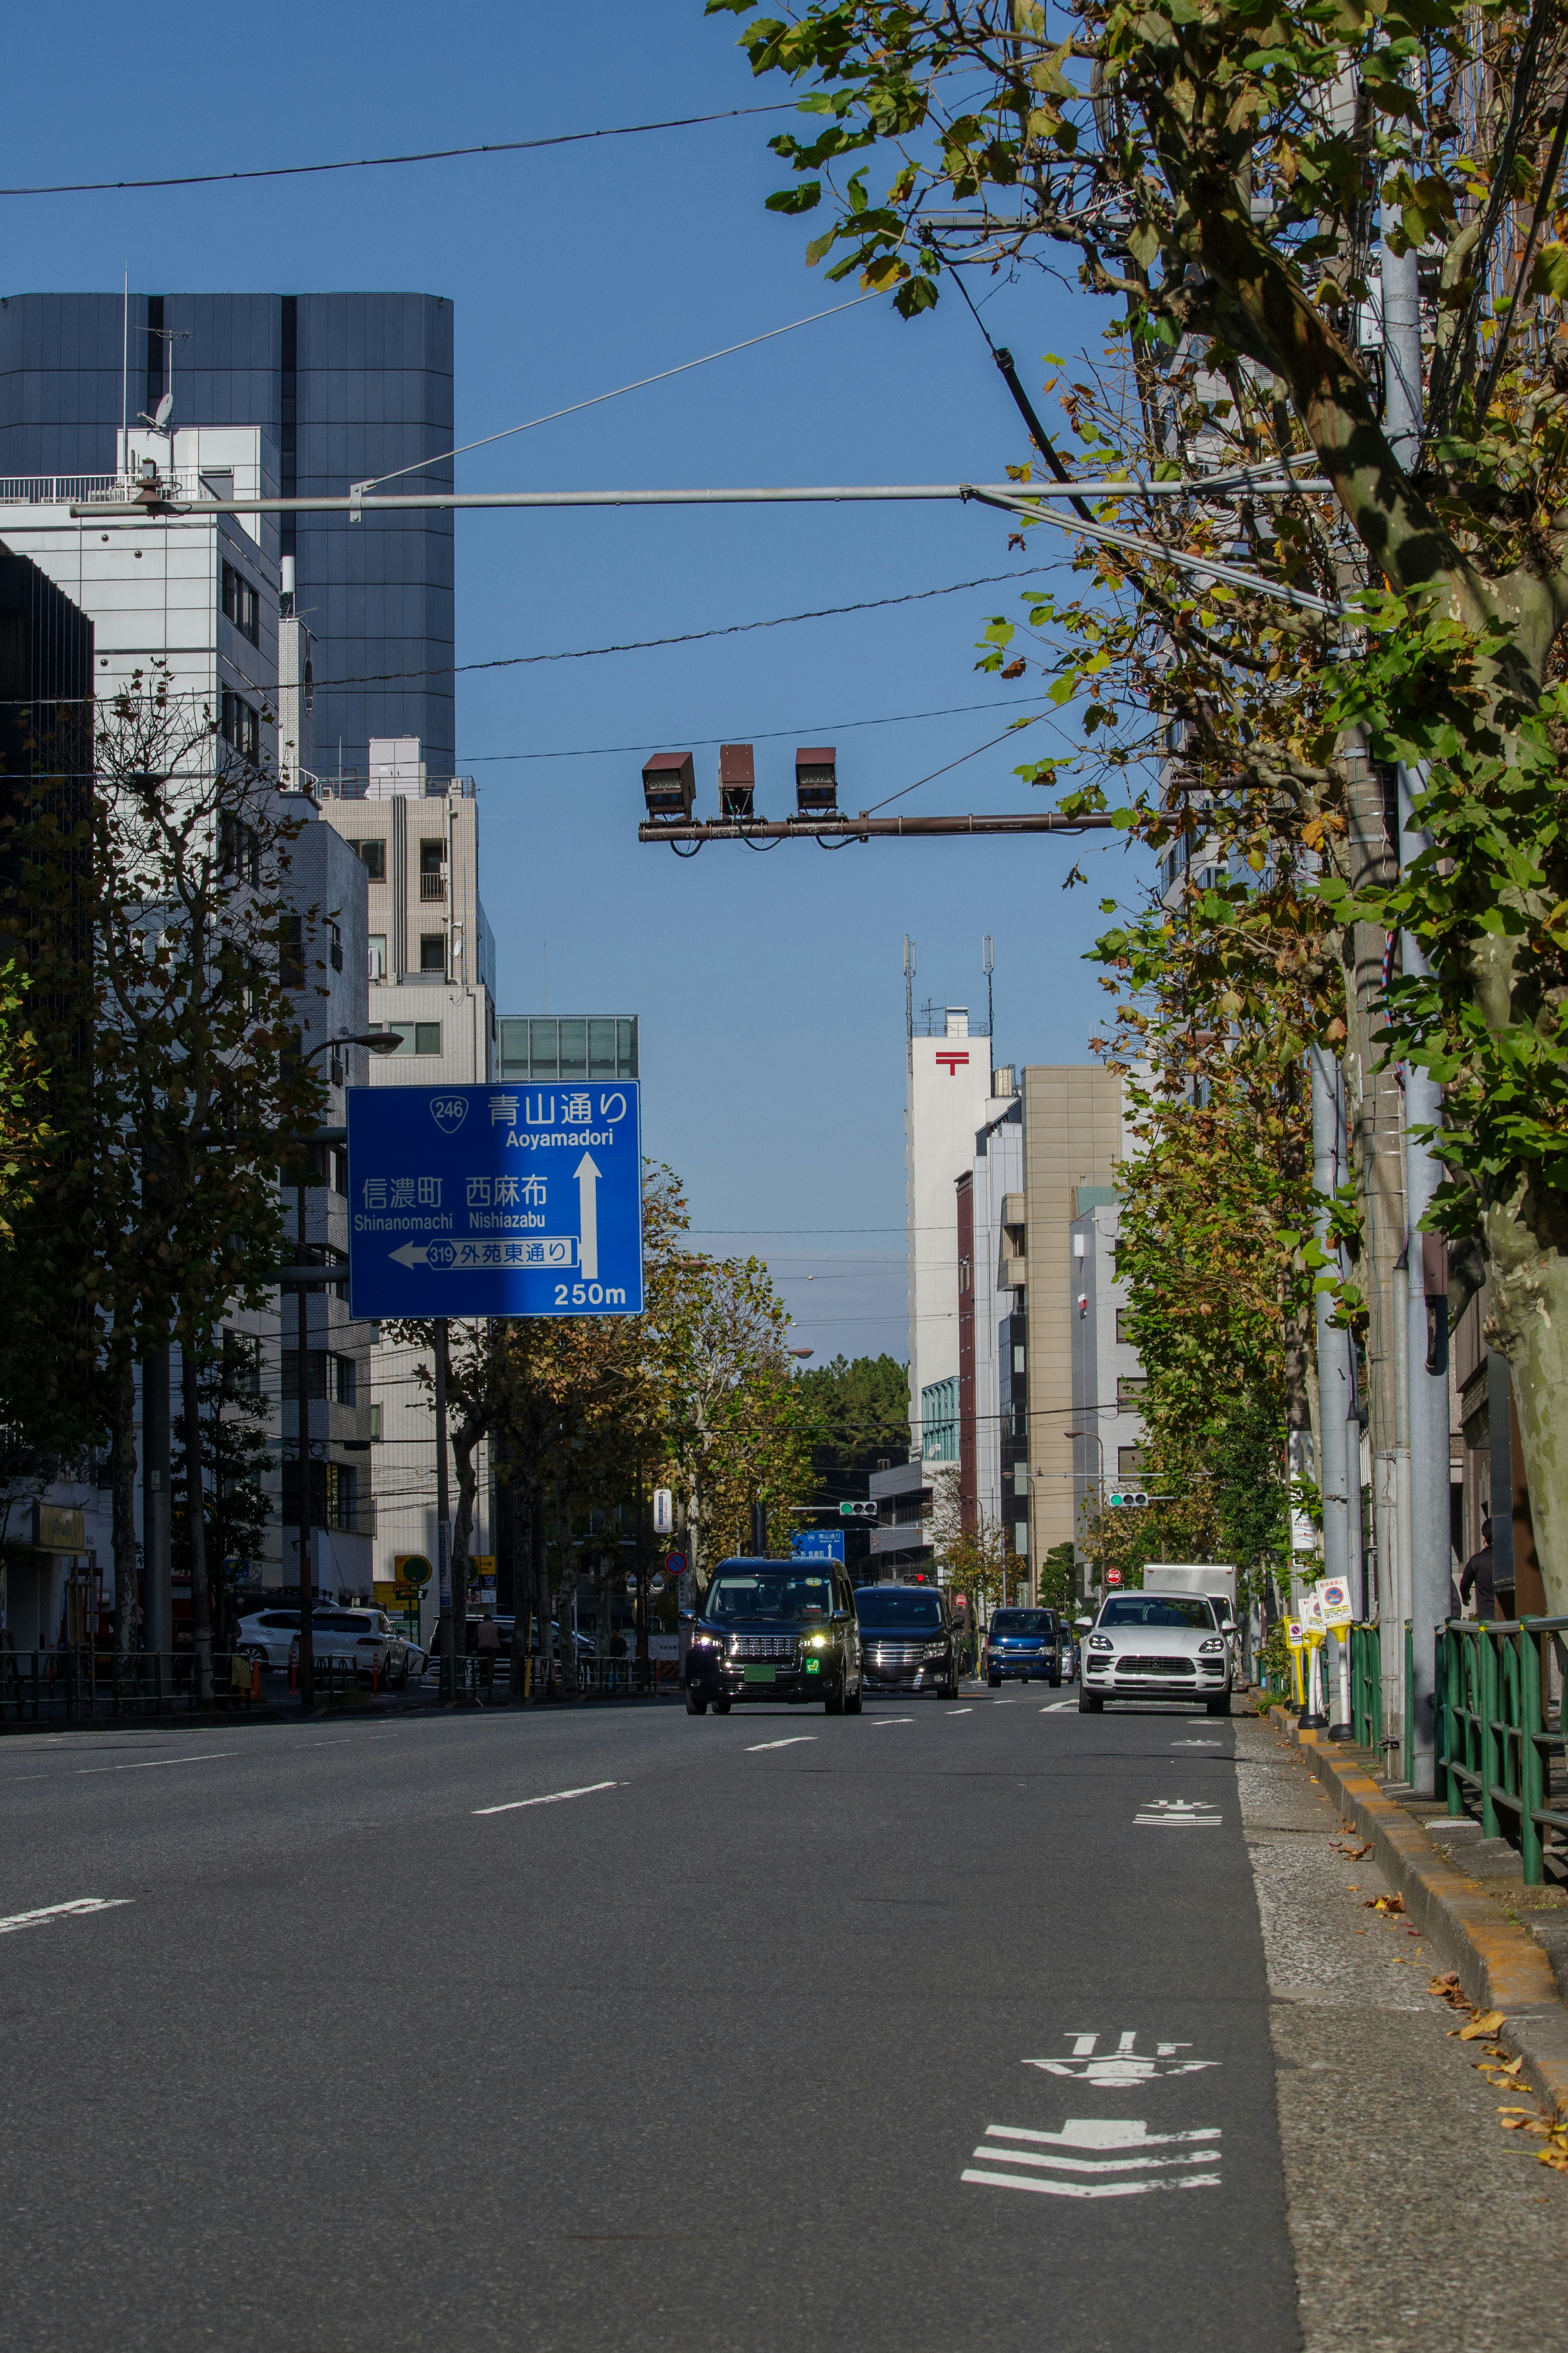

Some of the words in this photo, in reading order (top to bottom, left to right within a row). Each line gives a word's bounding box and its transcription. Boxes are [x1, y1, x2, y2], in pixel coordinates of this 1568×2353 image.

[435, 1102, 463, 1118] 246
[488, 1093, 627, 1126] 青山通り
[506, 1129, 613, 1150] Aoyamadori
[362, 1177, 443, 1209] 信濃町
[466, 1174, 548, 1207] 西麻布
[354, 1213, 453, 1231] Shinanomachi
[469, 1211, 545, 1229] Nishiazabu
[429, 1247, 454, 1262] 319
[460, 1242, 566, 1263] 外苑東通り
[555, 1283, 626, 1305] 250m
